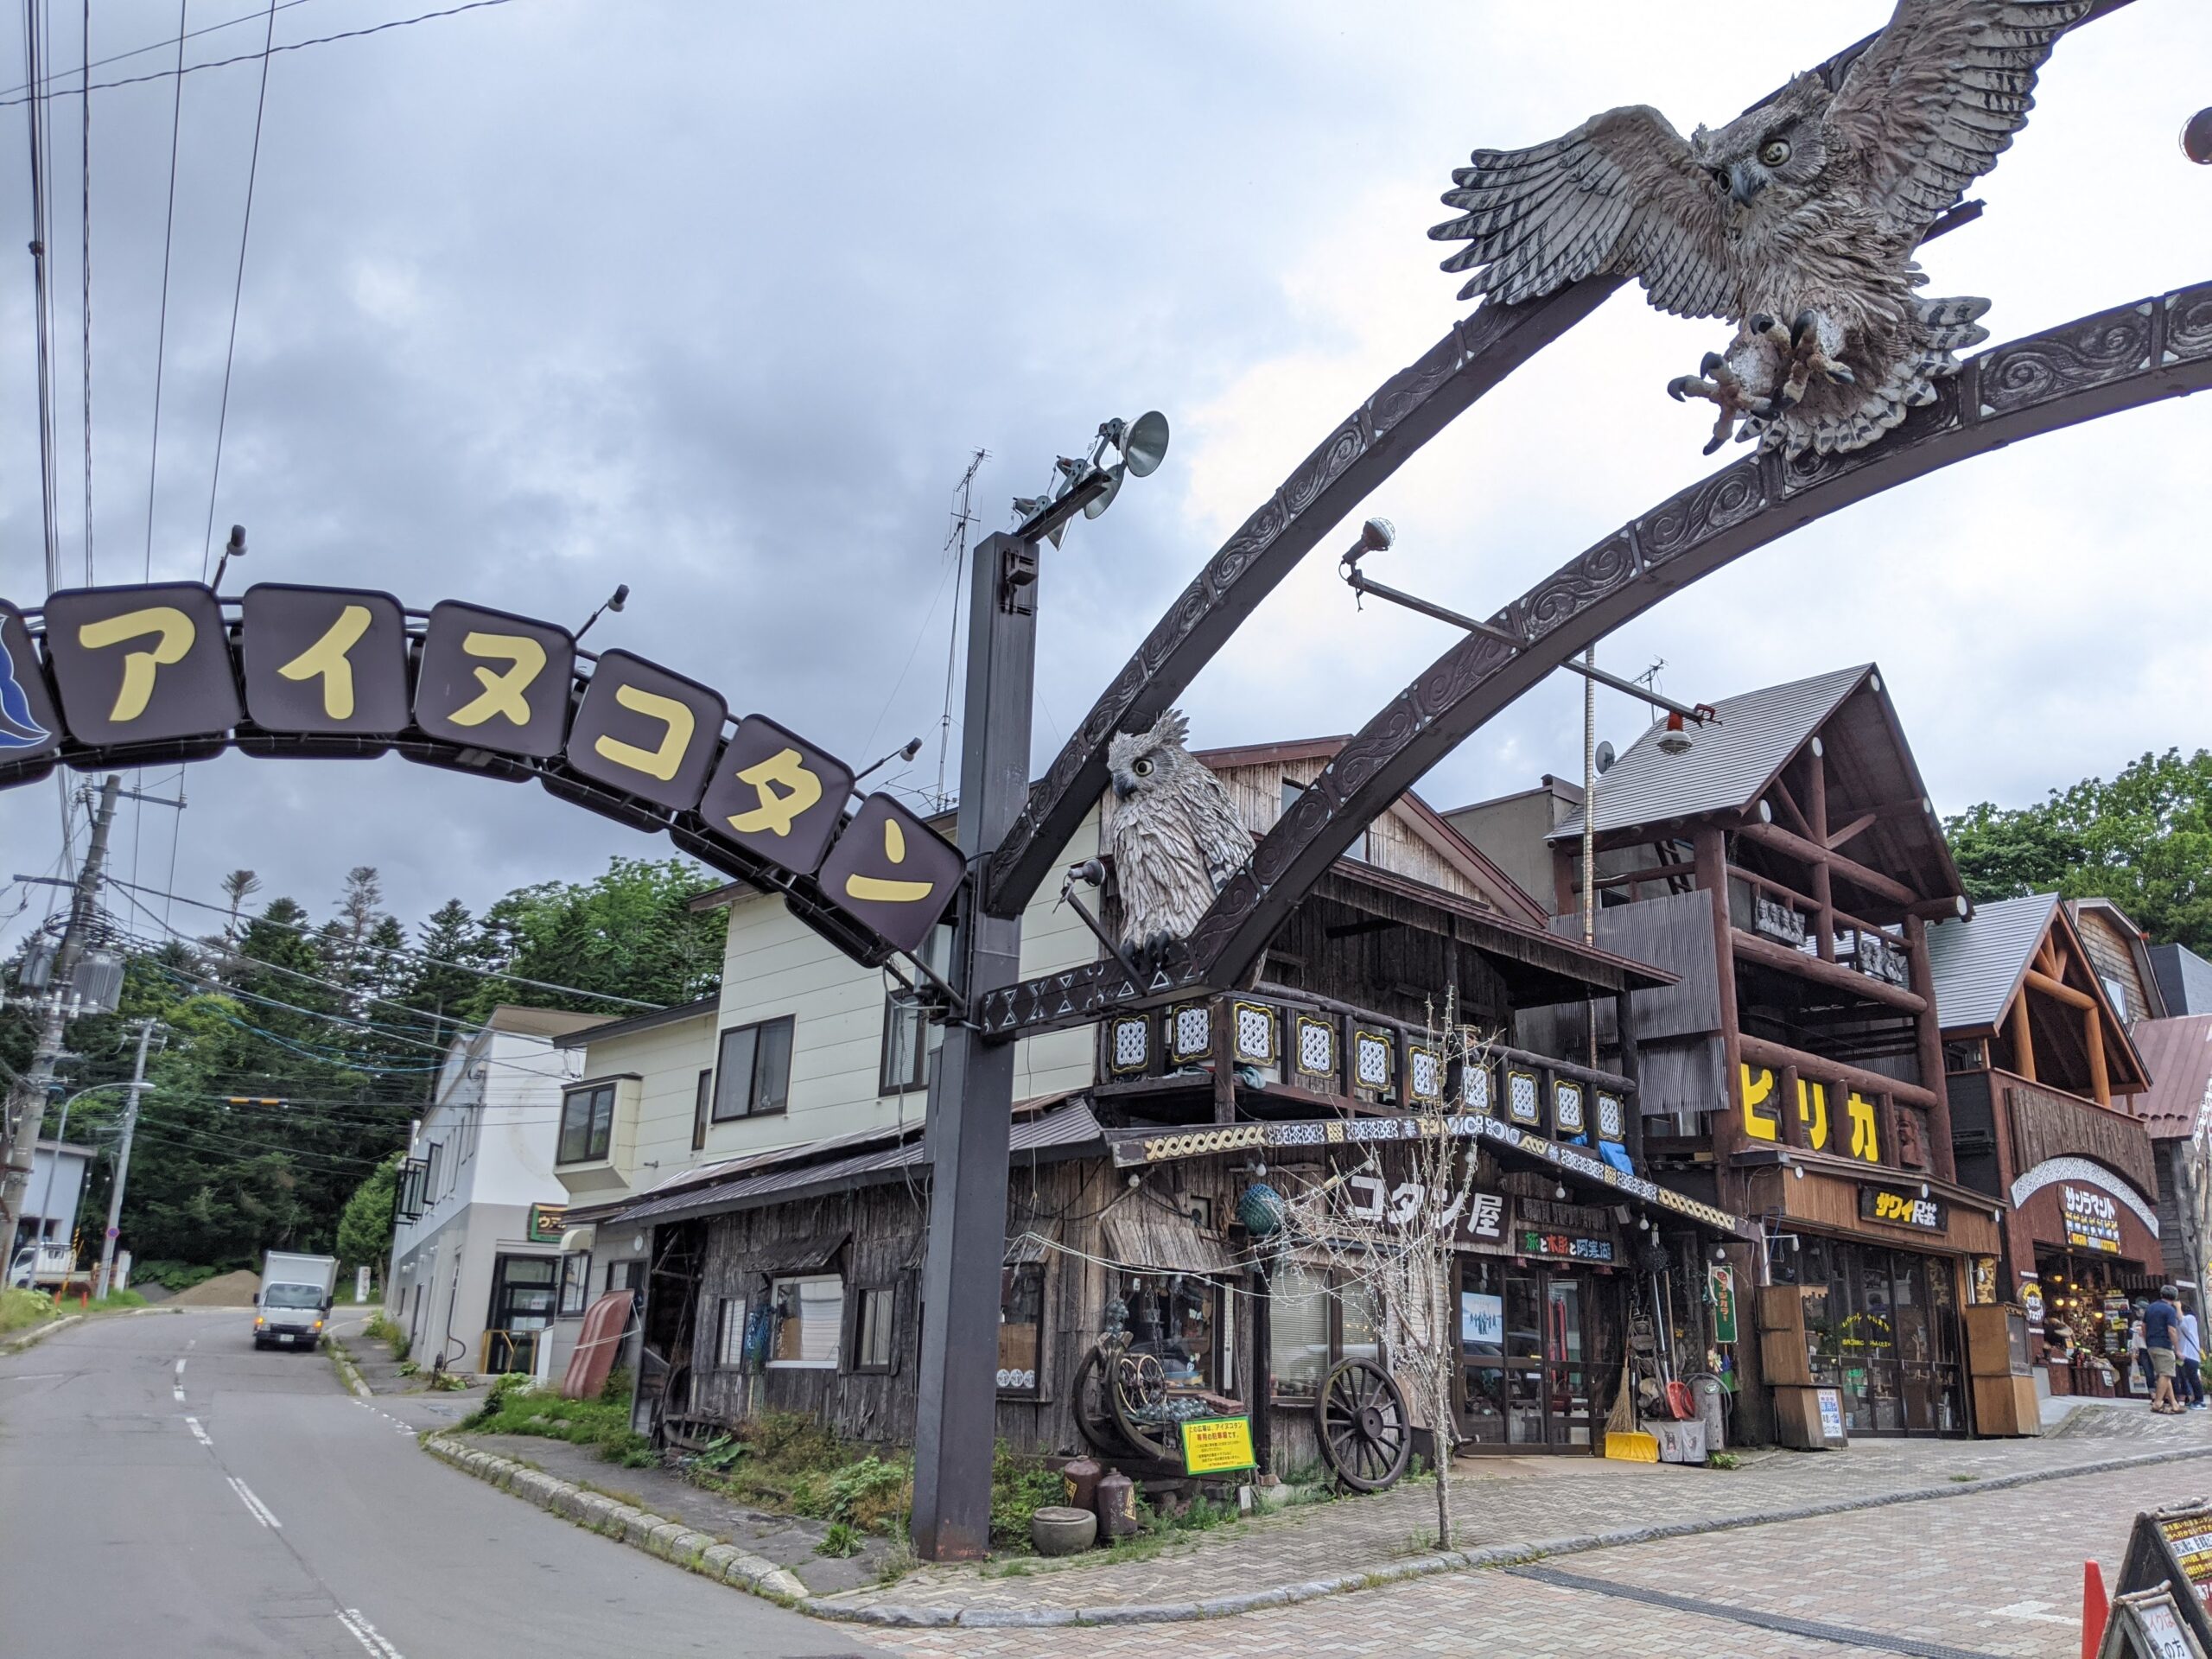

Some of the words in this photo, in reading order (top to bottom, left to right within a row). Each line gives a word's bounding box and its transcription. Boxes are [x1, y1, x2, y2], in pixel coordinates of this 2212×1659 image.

[79, 606, 933, 901] アイヌコタン
[1347, 1175, 1503, 1237] コタン屋
[1876, 1192, 1936, 1226] サワイ民芸
